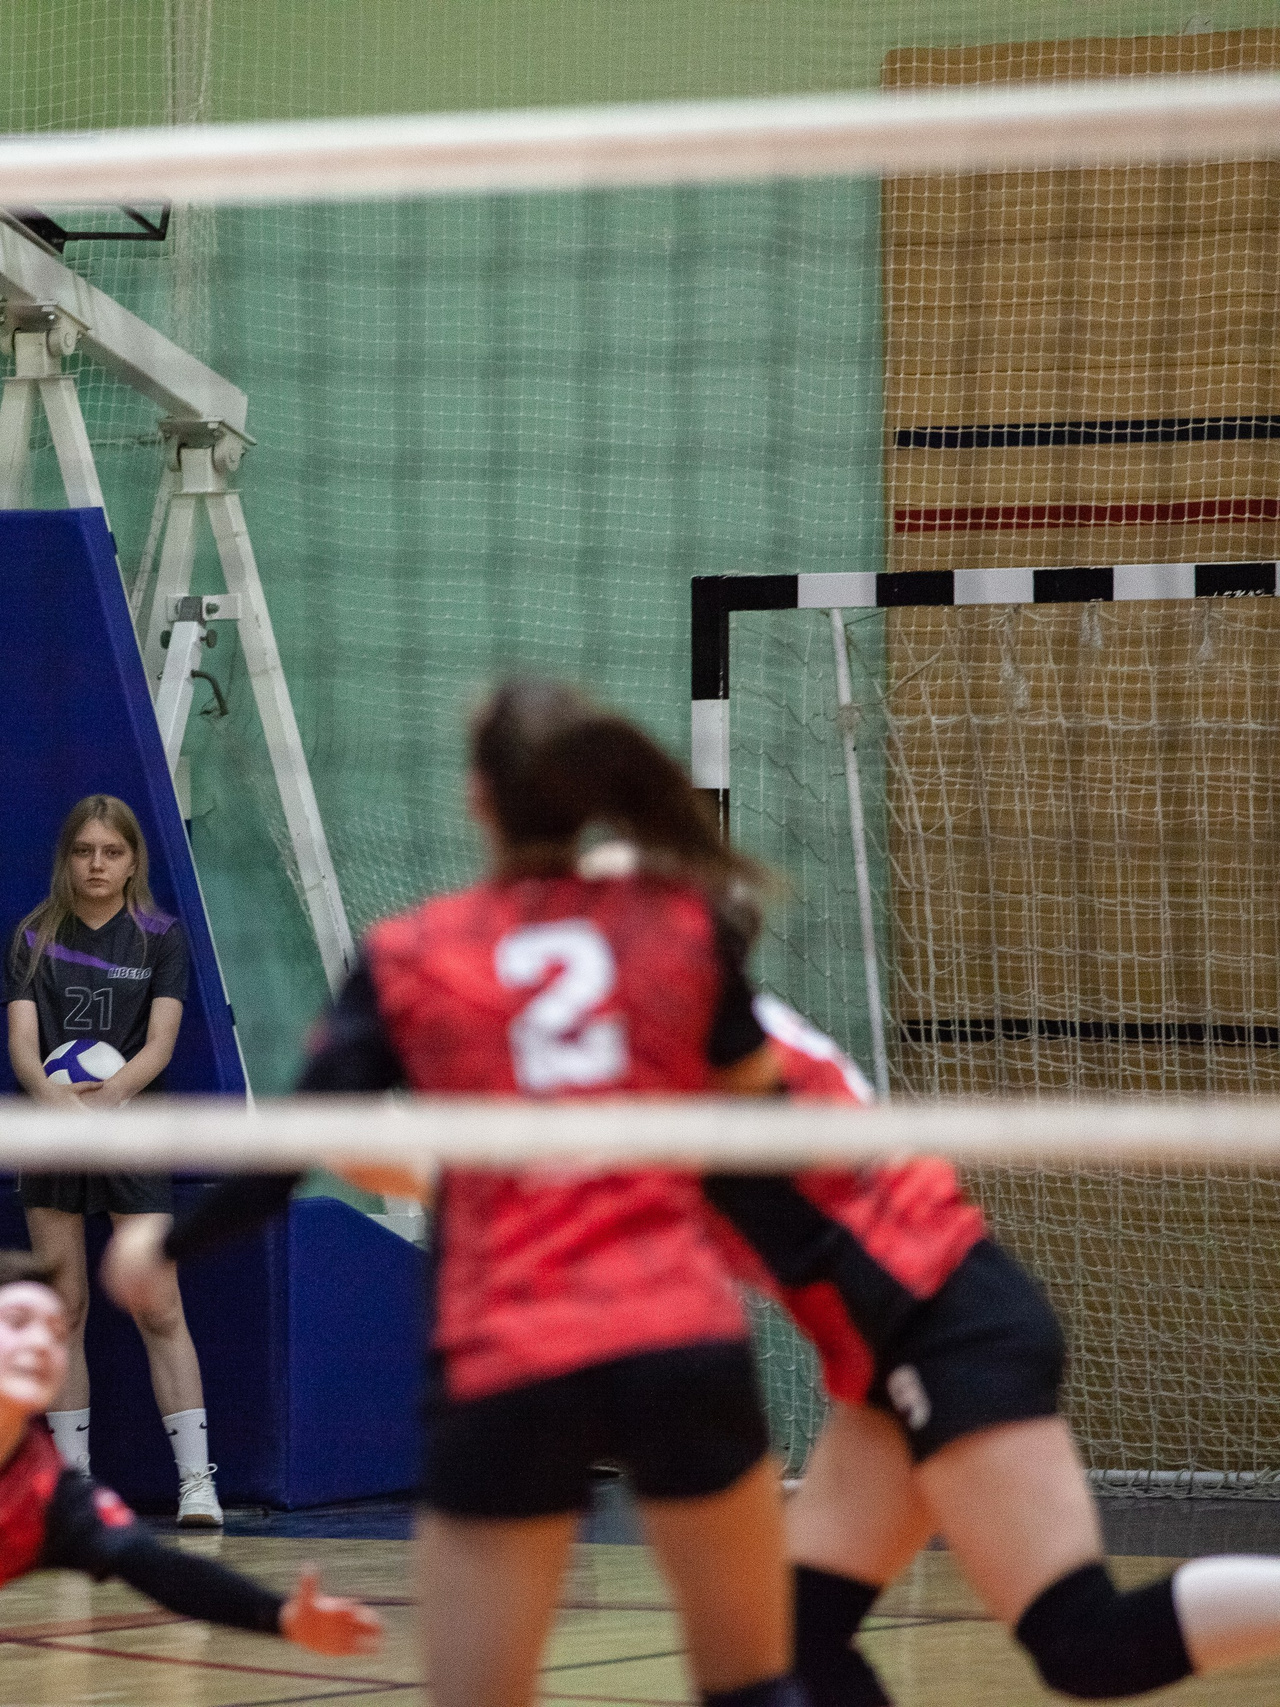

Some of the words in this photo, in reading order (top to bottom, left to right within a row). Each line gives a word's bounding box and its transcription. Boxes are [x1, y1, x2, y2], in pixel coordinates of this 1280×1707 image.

[107, 966, 152, 980] LIBERO
[63, 986, 113, 1031] 21
[495, 918, 627, 1089] 2
